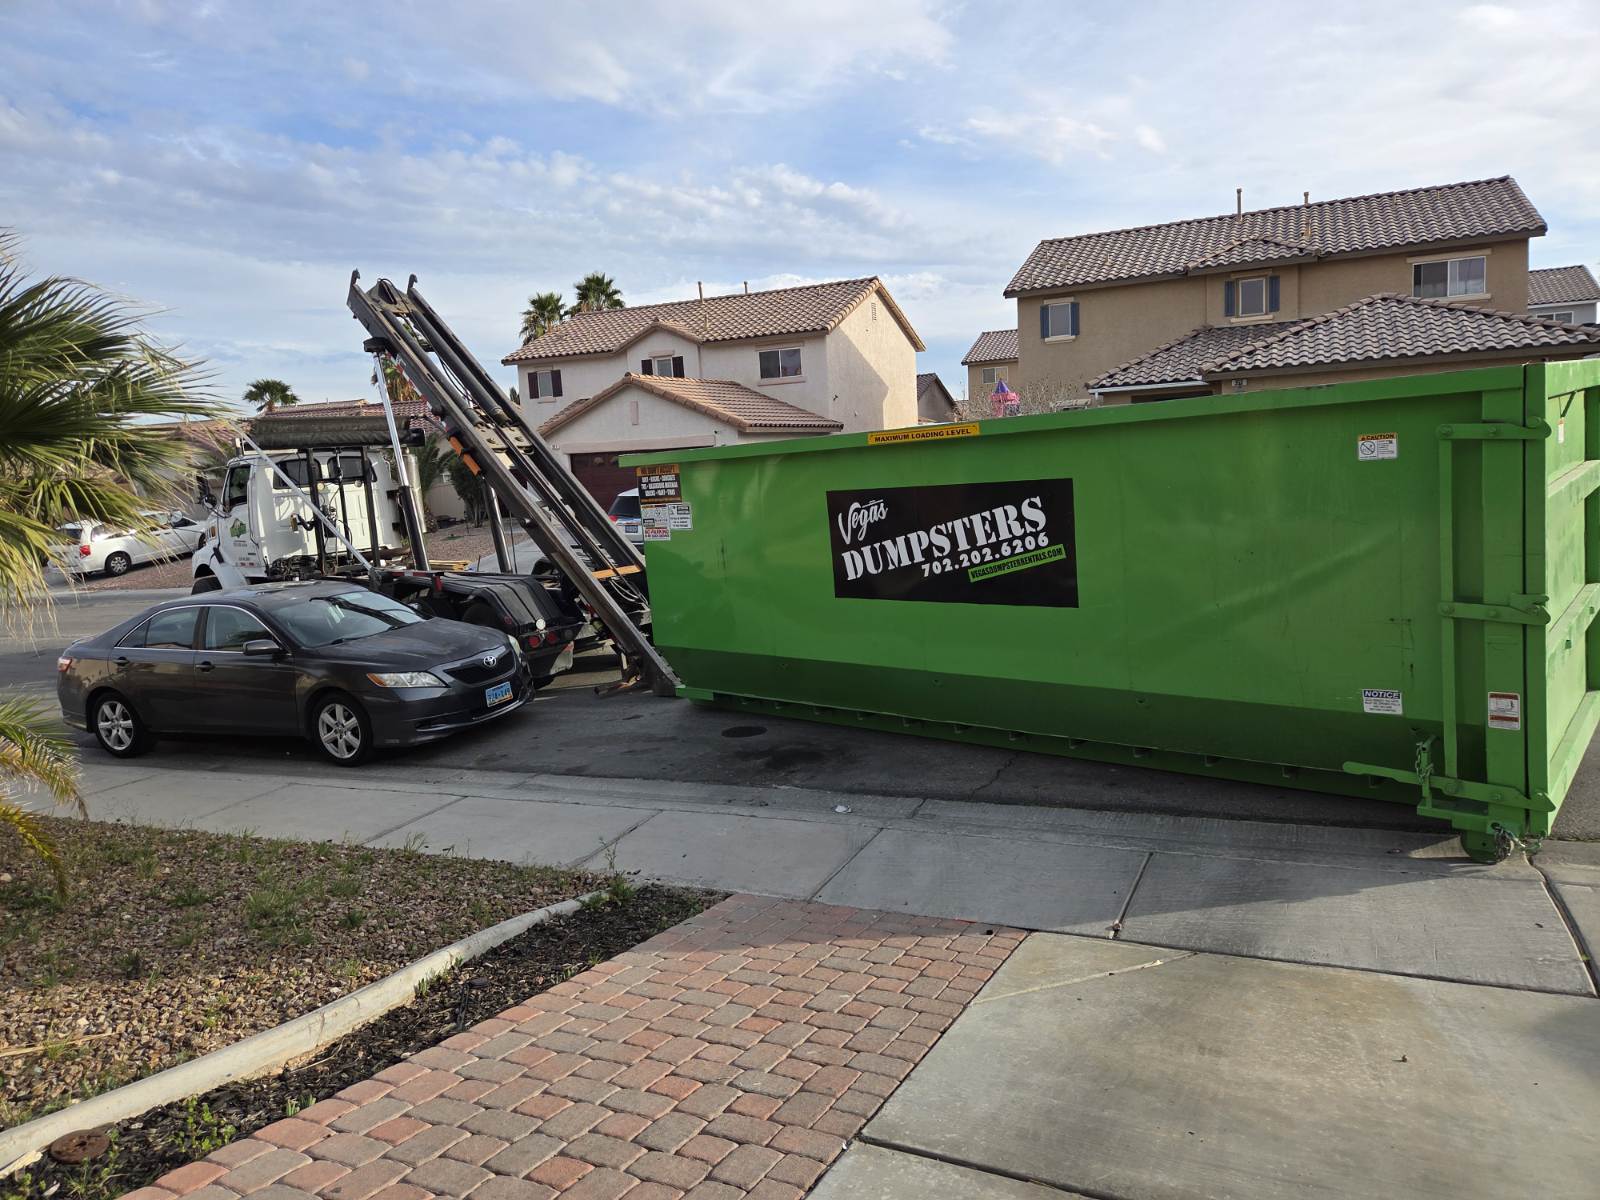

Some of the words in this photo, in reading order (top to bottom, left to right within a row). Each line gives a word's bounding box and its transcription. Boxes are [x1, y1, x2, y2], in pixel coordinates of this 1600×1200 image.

[874, 434, 909, 443] MAXIMUM
[911, 430, 945, 440] LOADING
[946, 428, 972, 437] LEVEL
[838, 499, 889, 545] Vegas
[841, 495, 1047, 581] DUMPSTERS
[921, 531, 1050, 578] 702.202.6206
[970, 549, 1064, 580] VEGASDUMPSTERRENTALS.COM
[1364, 691, 1400, 699] NOTICE
